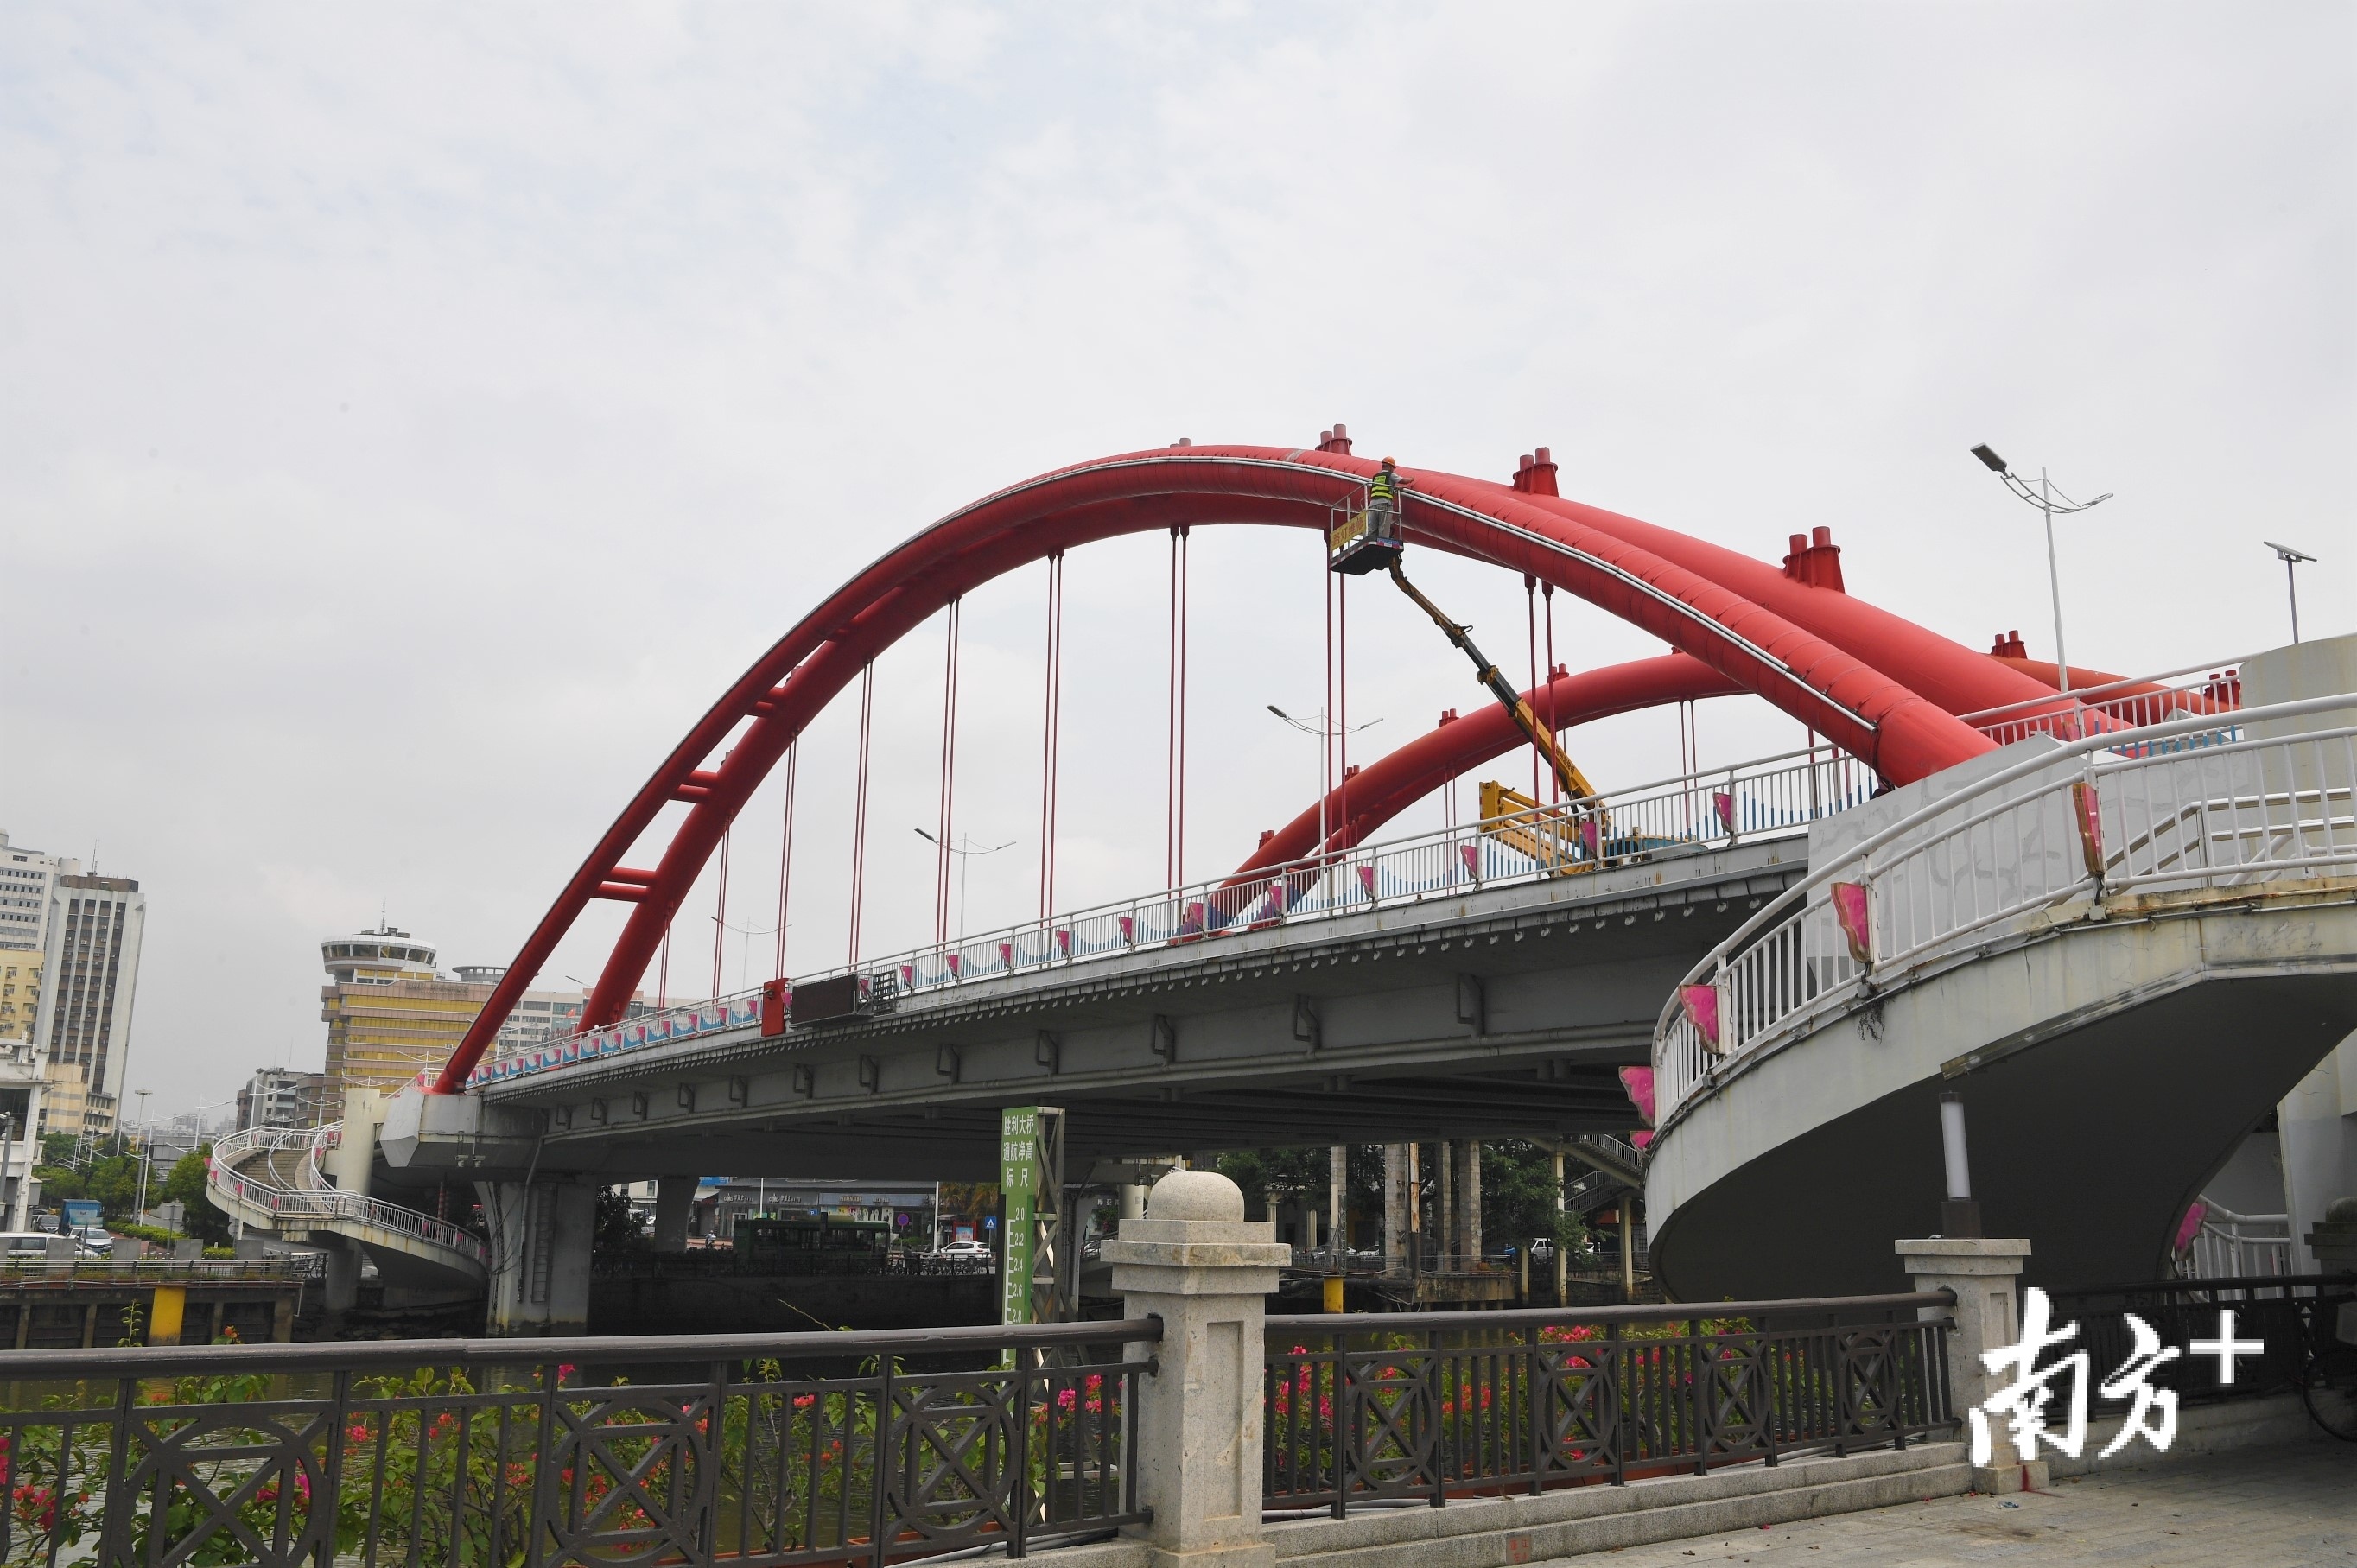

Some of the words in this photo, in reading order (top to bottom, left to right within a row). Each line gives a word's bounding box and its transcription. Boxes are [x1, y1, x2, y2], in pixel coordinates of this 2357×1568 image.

[1003, 1114, 1034, 1136] 胜利大桥
[1002, 1139, 1033, 1162] 通航净高
[1015, 1207, 1025, 1221] 2.0
[1014, 1232, 1024, 1247] 2.2
[1013, 1258, 1023, 1273] 2.4
[1013, 1283, 1022, 1298] 2.6
[1012, 1308, 1022, 1323] 2.8
